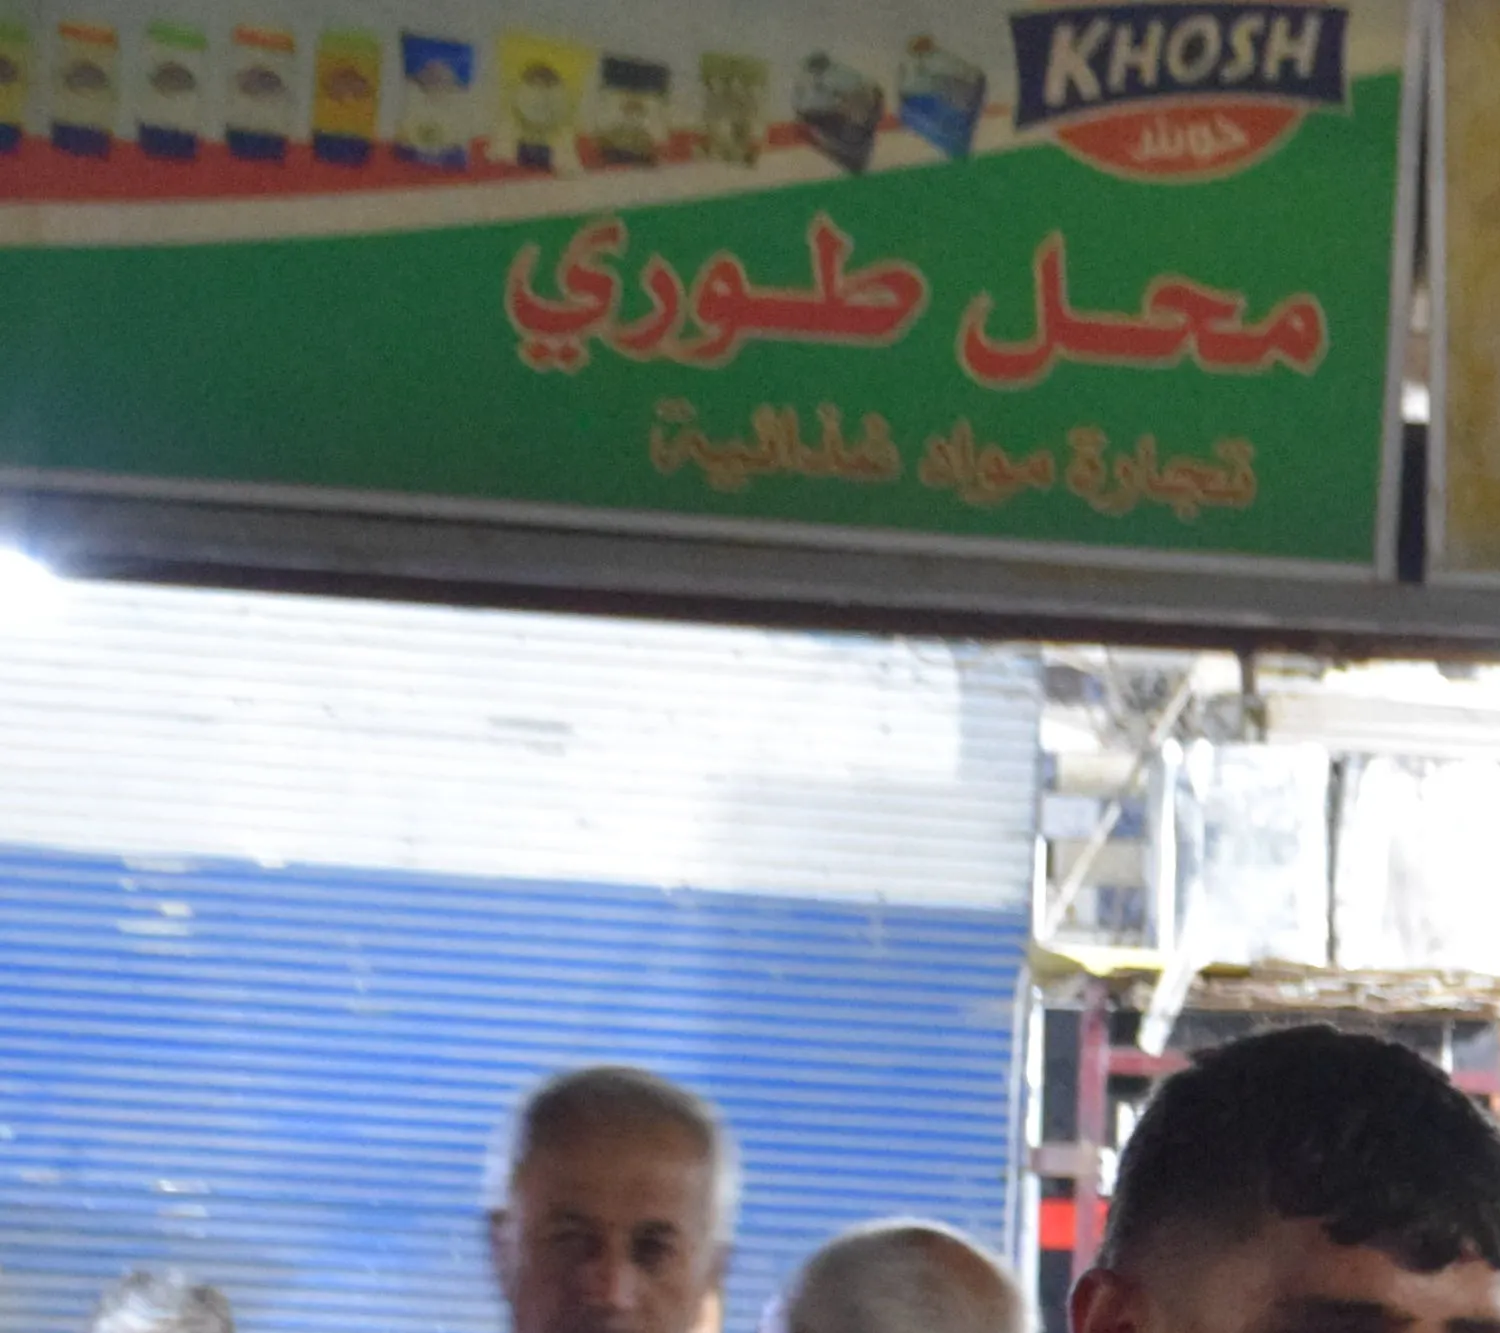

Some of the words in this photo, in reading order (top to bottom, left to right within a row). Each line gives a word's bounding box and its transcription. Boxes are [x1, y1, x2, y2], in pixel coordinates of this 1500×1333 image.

[1043, 12, 1326, 106] KHOSH
[505, 211, 929, 374] طوري
[958, 230, 1330, 391] محل
[920, 418, 1056, 505] مواد
